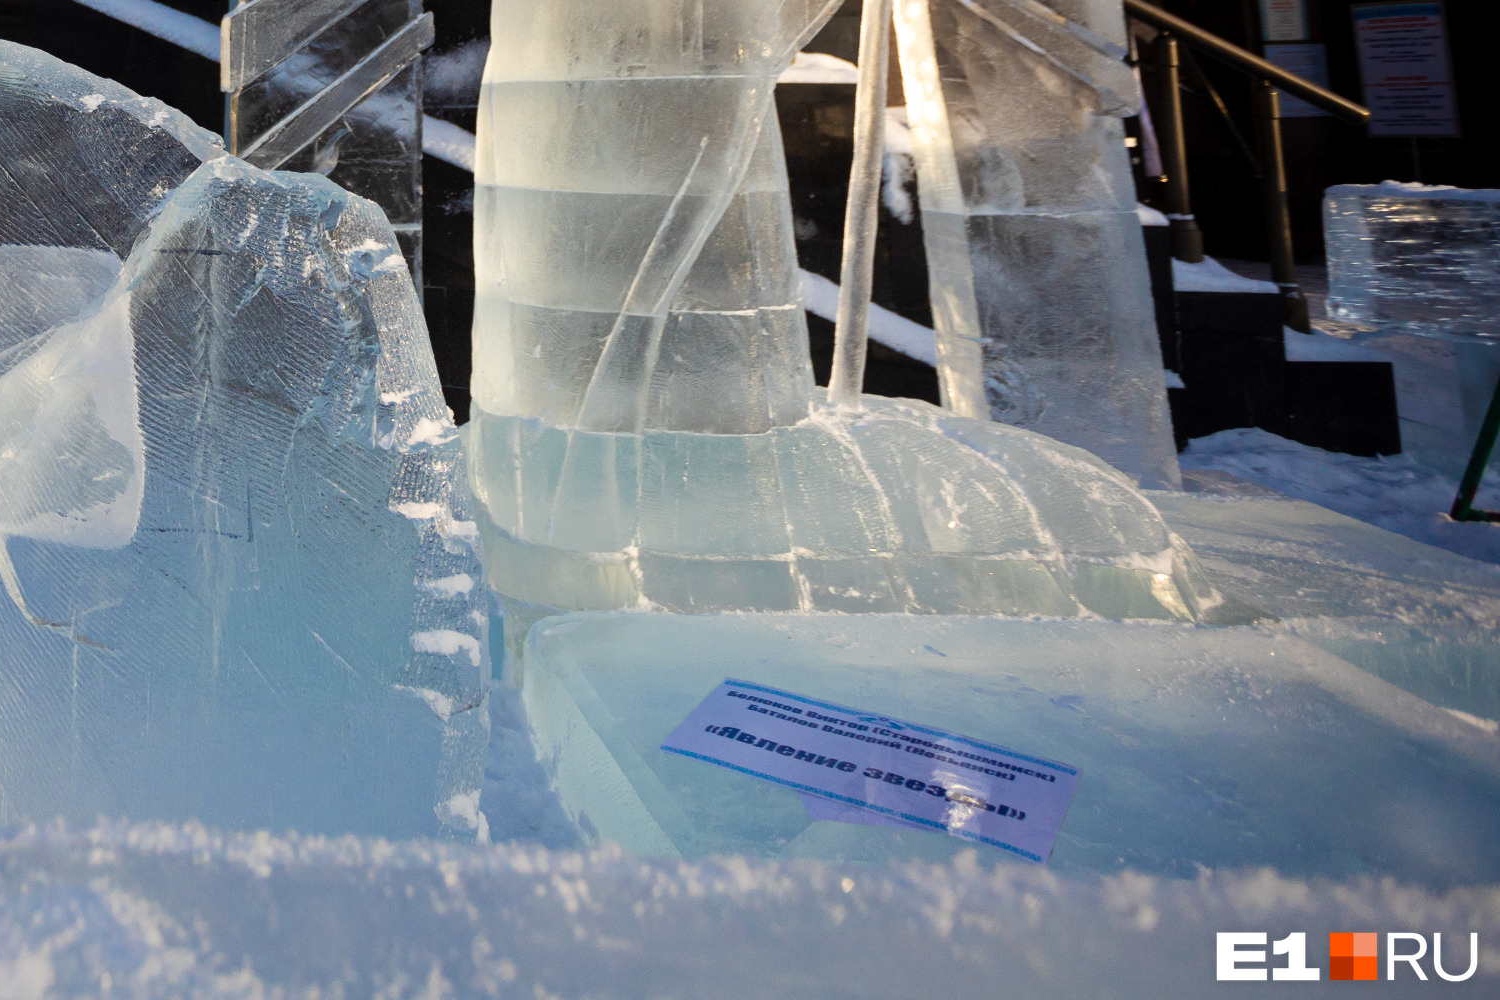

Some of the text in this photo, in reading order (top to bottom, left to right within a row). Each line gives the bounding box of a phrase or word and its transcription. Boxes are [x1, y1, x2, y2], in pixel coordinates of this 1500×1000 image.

[746, 703, 819, 729] Баталов
[821, 724, 902, 750] Валерий
[806, 710, 870, 732] Виктор
[704, 724, 858, 773] «Явление
